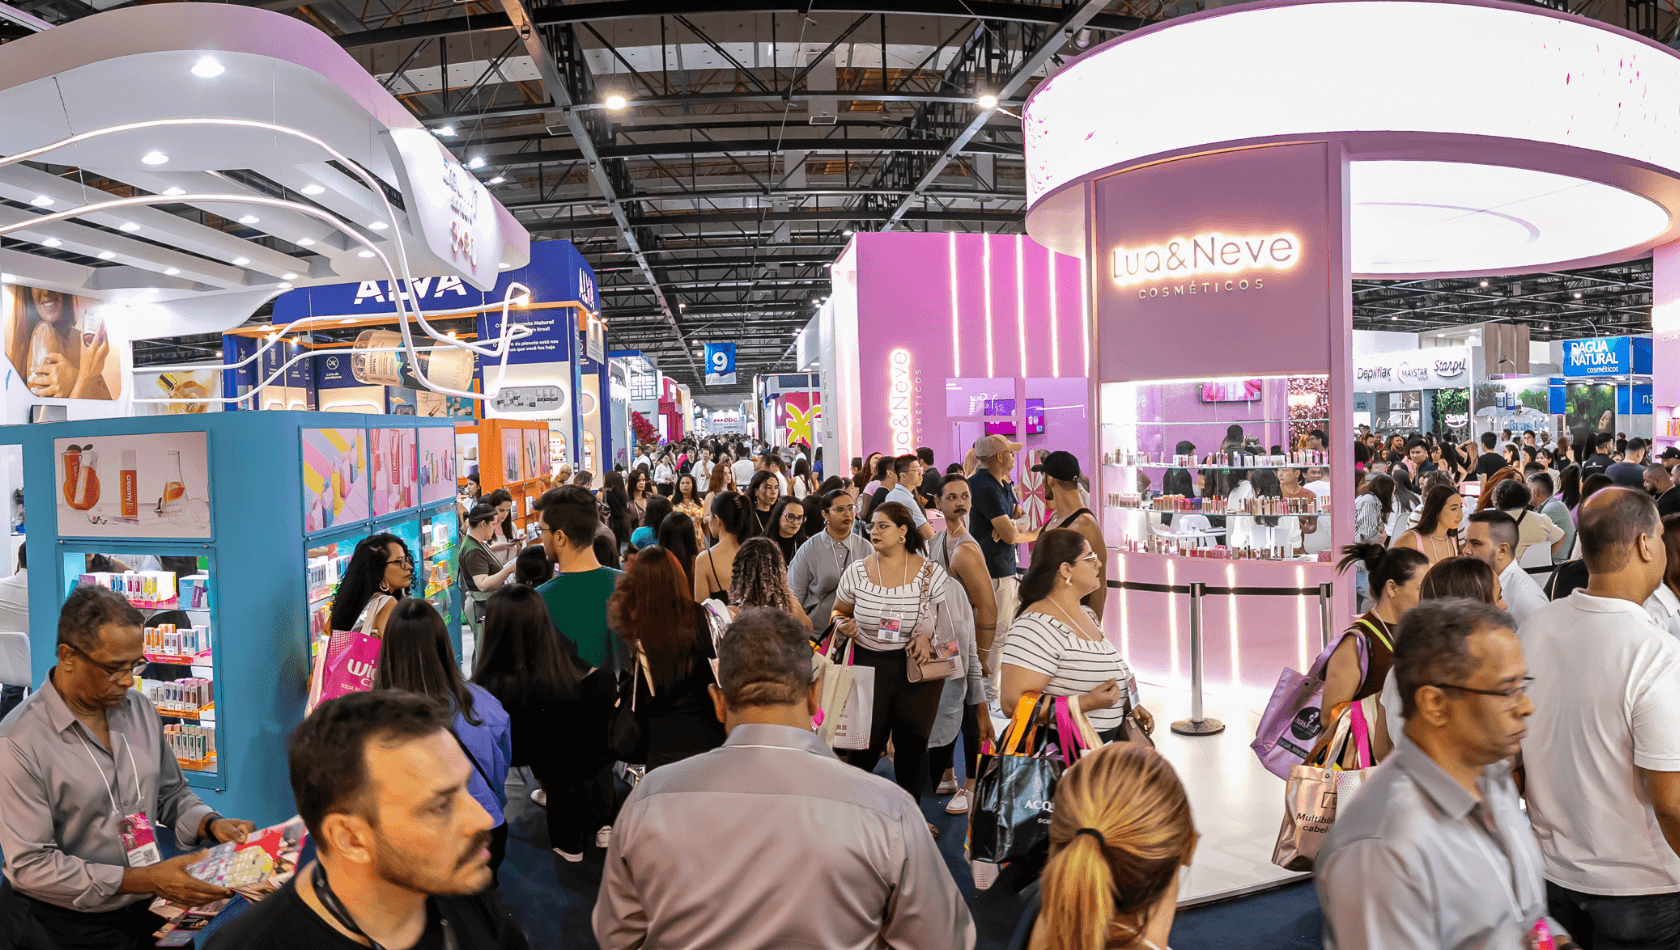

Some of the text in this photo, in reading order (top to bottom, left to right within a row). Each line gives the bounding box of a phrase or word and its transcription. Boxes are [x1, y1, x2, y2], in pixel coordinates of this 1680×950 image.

[1113, 236, 1293, 279] Lua&Neve
[1138, 278, 1264, 300] COSMÉTICOS
[712, 352, 728, 371] 9
[1433, 358, 1467, 374] Starpil
[1571, 351, 1619, 366] NATURAL
[1587, 365, 1619, 374] cosméticos
[891, 351, 910, 457] ua&Neve
[915, 369, 923, 445] OSMÉTICOS
